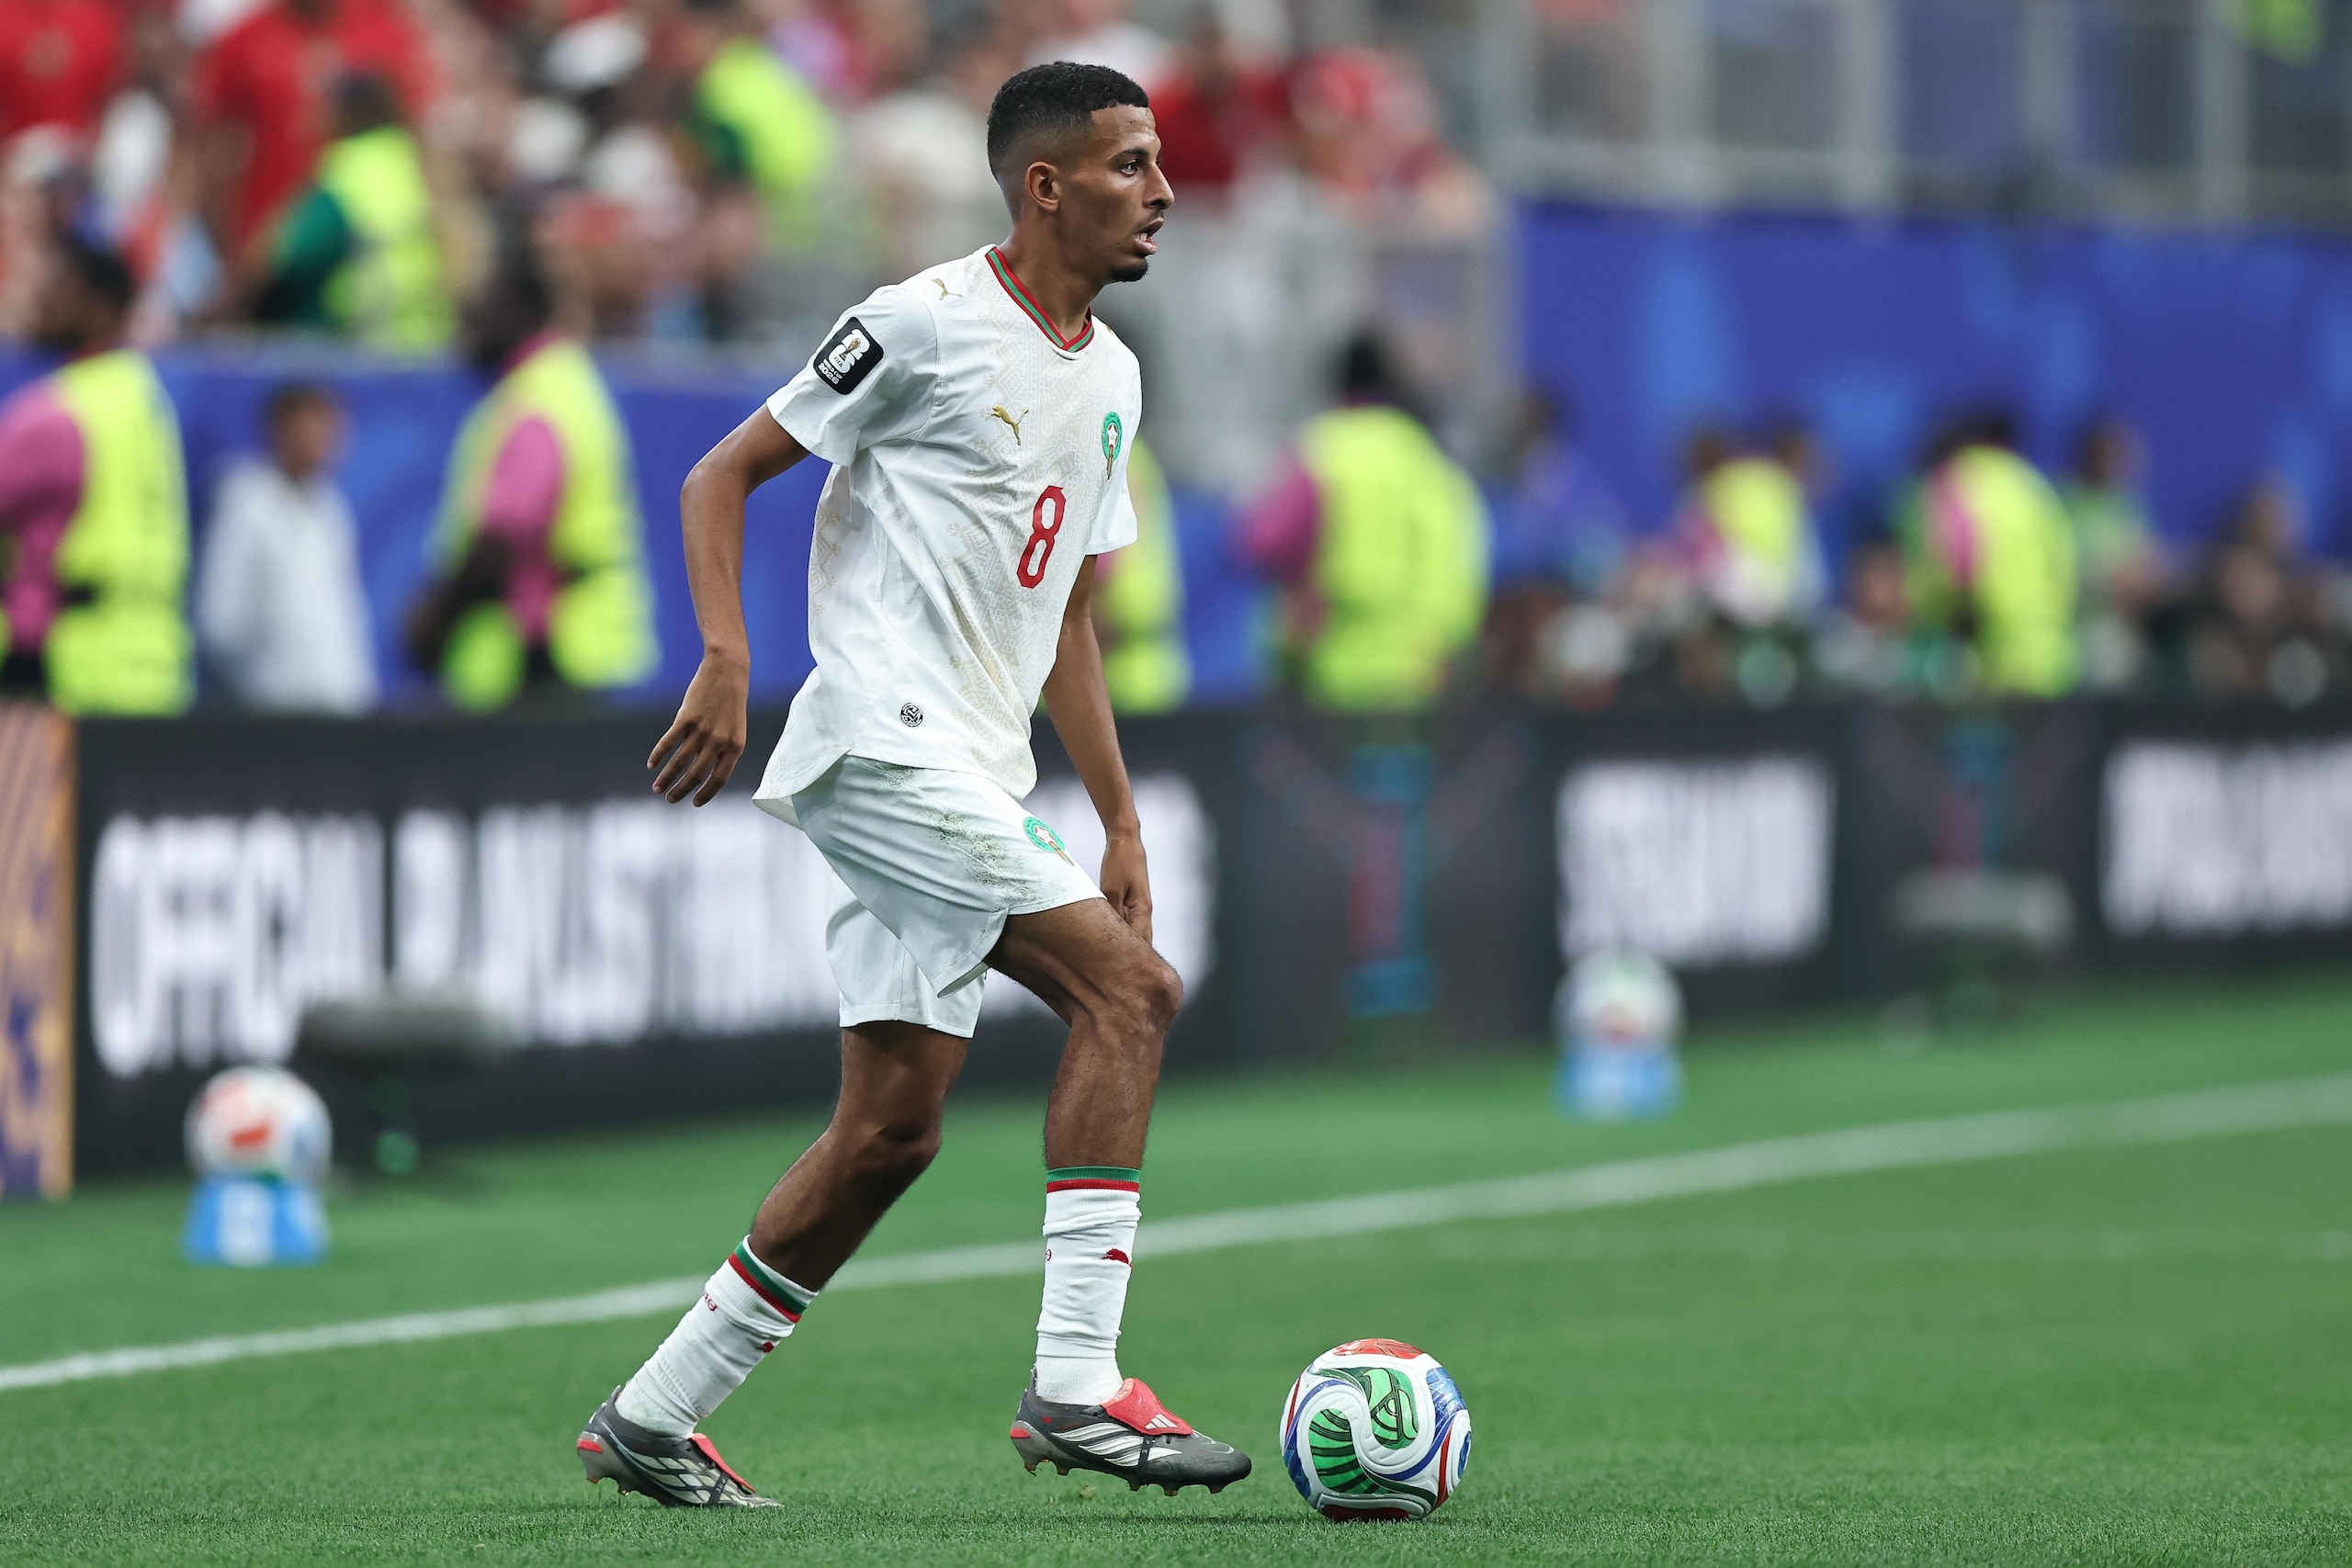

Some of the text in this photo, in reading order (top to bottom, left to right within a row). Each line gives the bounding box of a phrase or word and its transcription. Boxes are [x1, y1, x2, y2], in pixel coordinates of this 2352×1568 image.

[833, 356, 843, 368] FIFA
[818, 362, 840, 385] 2026
[833, 370, 843, 379] CUP
[1016, 485, 1066, 589] 8
